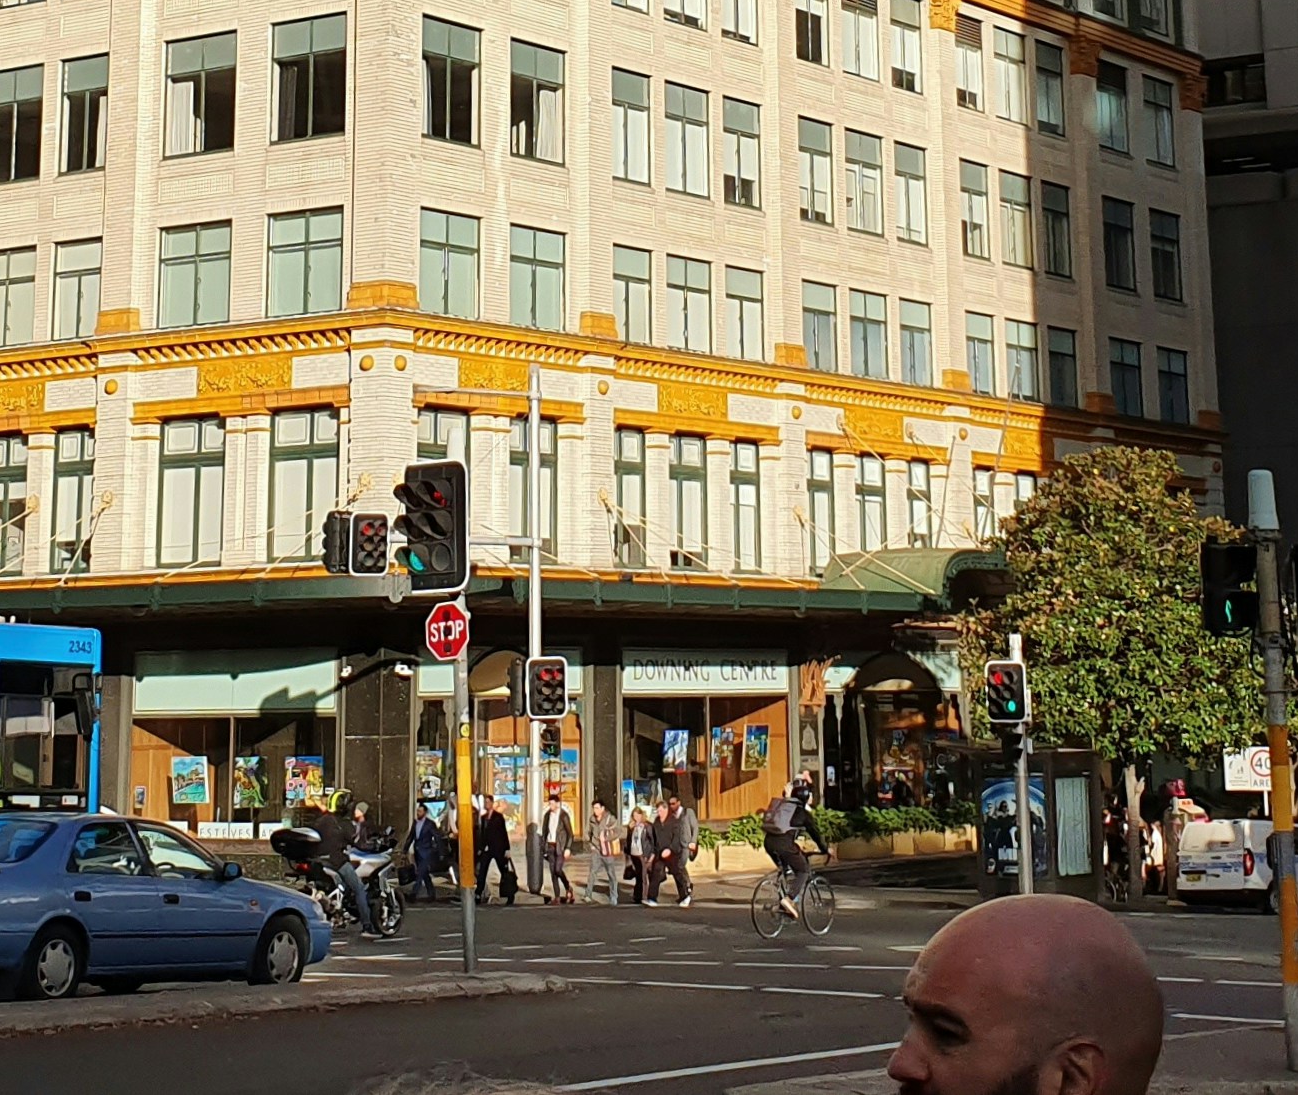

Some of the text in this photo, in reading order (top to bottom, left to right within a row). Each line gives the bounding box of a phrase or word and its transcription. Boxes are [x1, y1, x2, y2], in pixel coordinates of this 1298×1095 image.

[429, 619, 464, 643] STOP
[68, 639, 93, 654] 2343
[633, 658, 778, 682] DOWNING CENTRE
[1254, 754, 1272, 770] 40
[199, 828, 252, 839] ESTEVES
